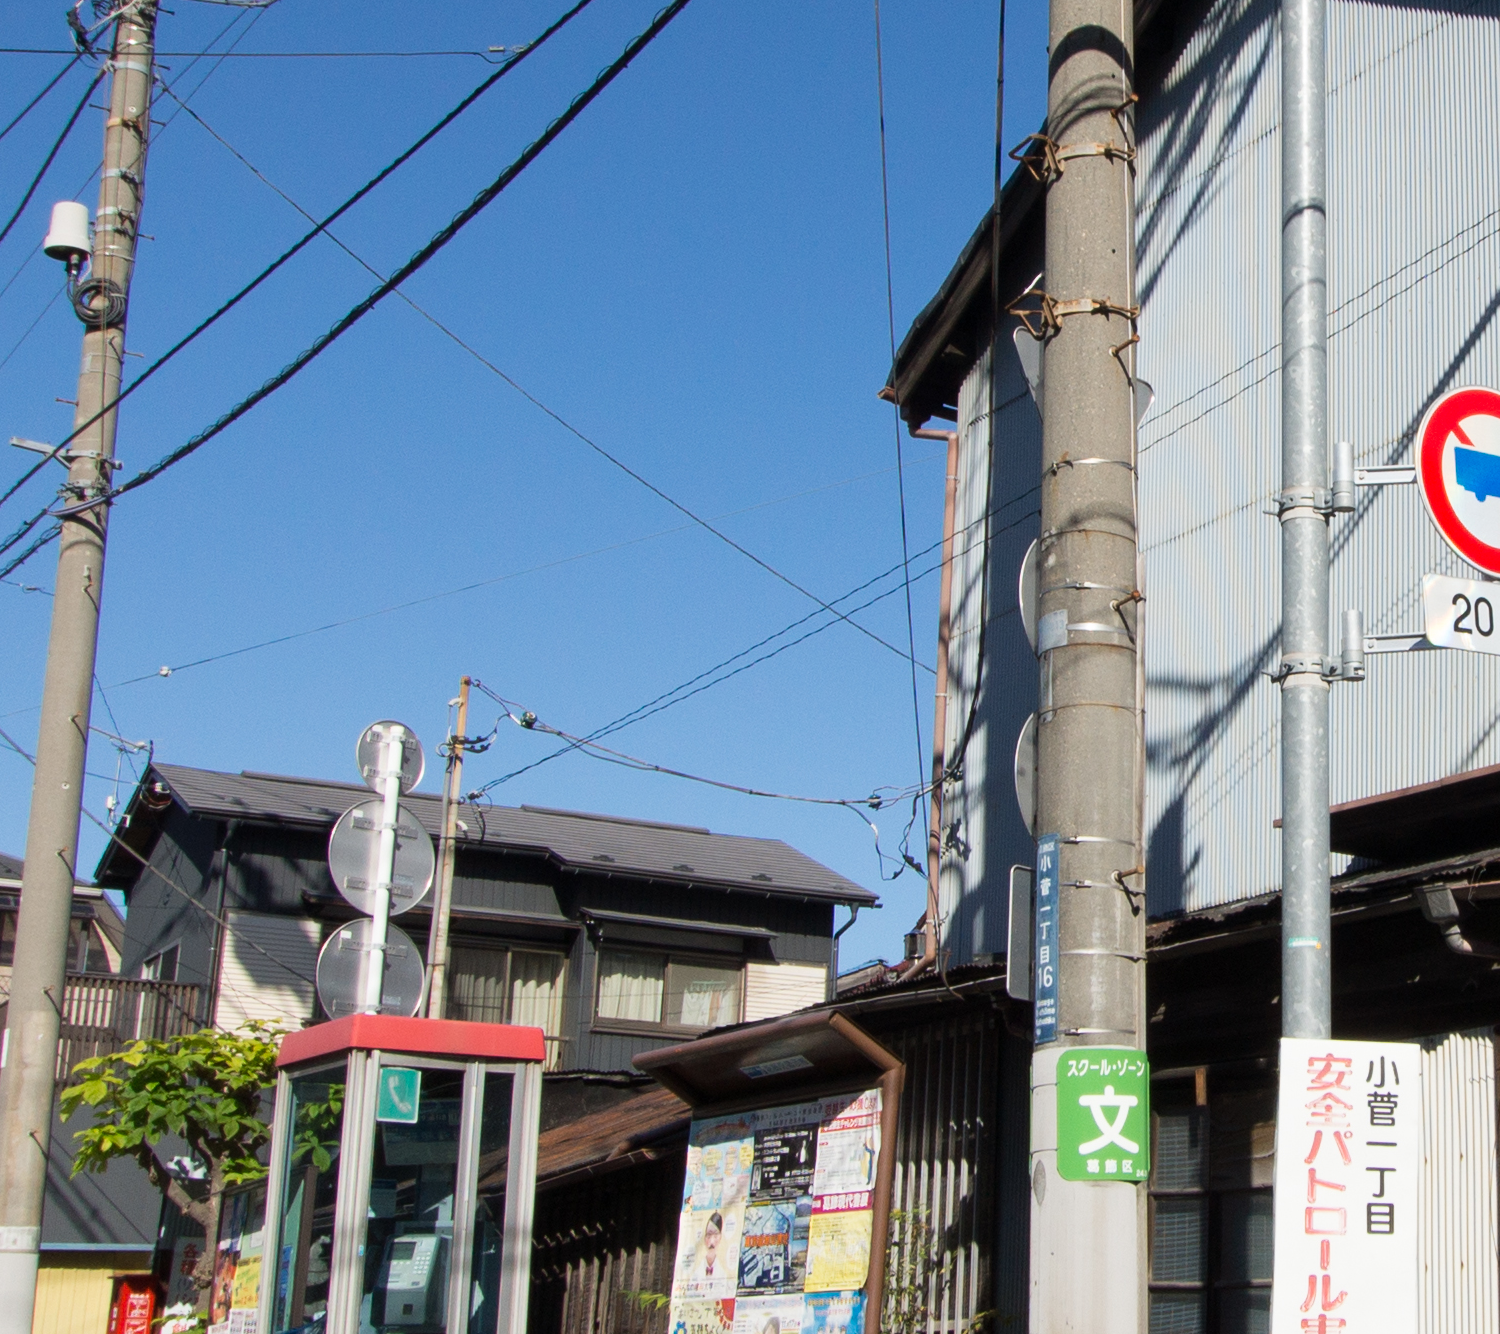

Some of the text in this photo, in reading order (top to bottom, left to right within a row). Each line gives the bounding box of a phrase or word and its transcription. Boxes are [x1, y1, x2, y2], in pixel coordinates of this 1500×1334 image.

[1039, 854, 1052, 965] 小菅一丁目
[1037, 965, 1054, 990] 16
[1066, 1058, 1146, 1078] スクール・ゾーン
[1077, 1085, 1140, 1156] 文
[1086, 1158, 1134, 1175] 葛飾区
[1364, 1053, 1401, 1237] 小菅一丁目
